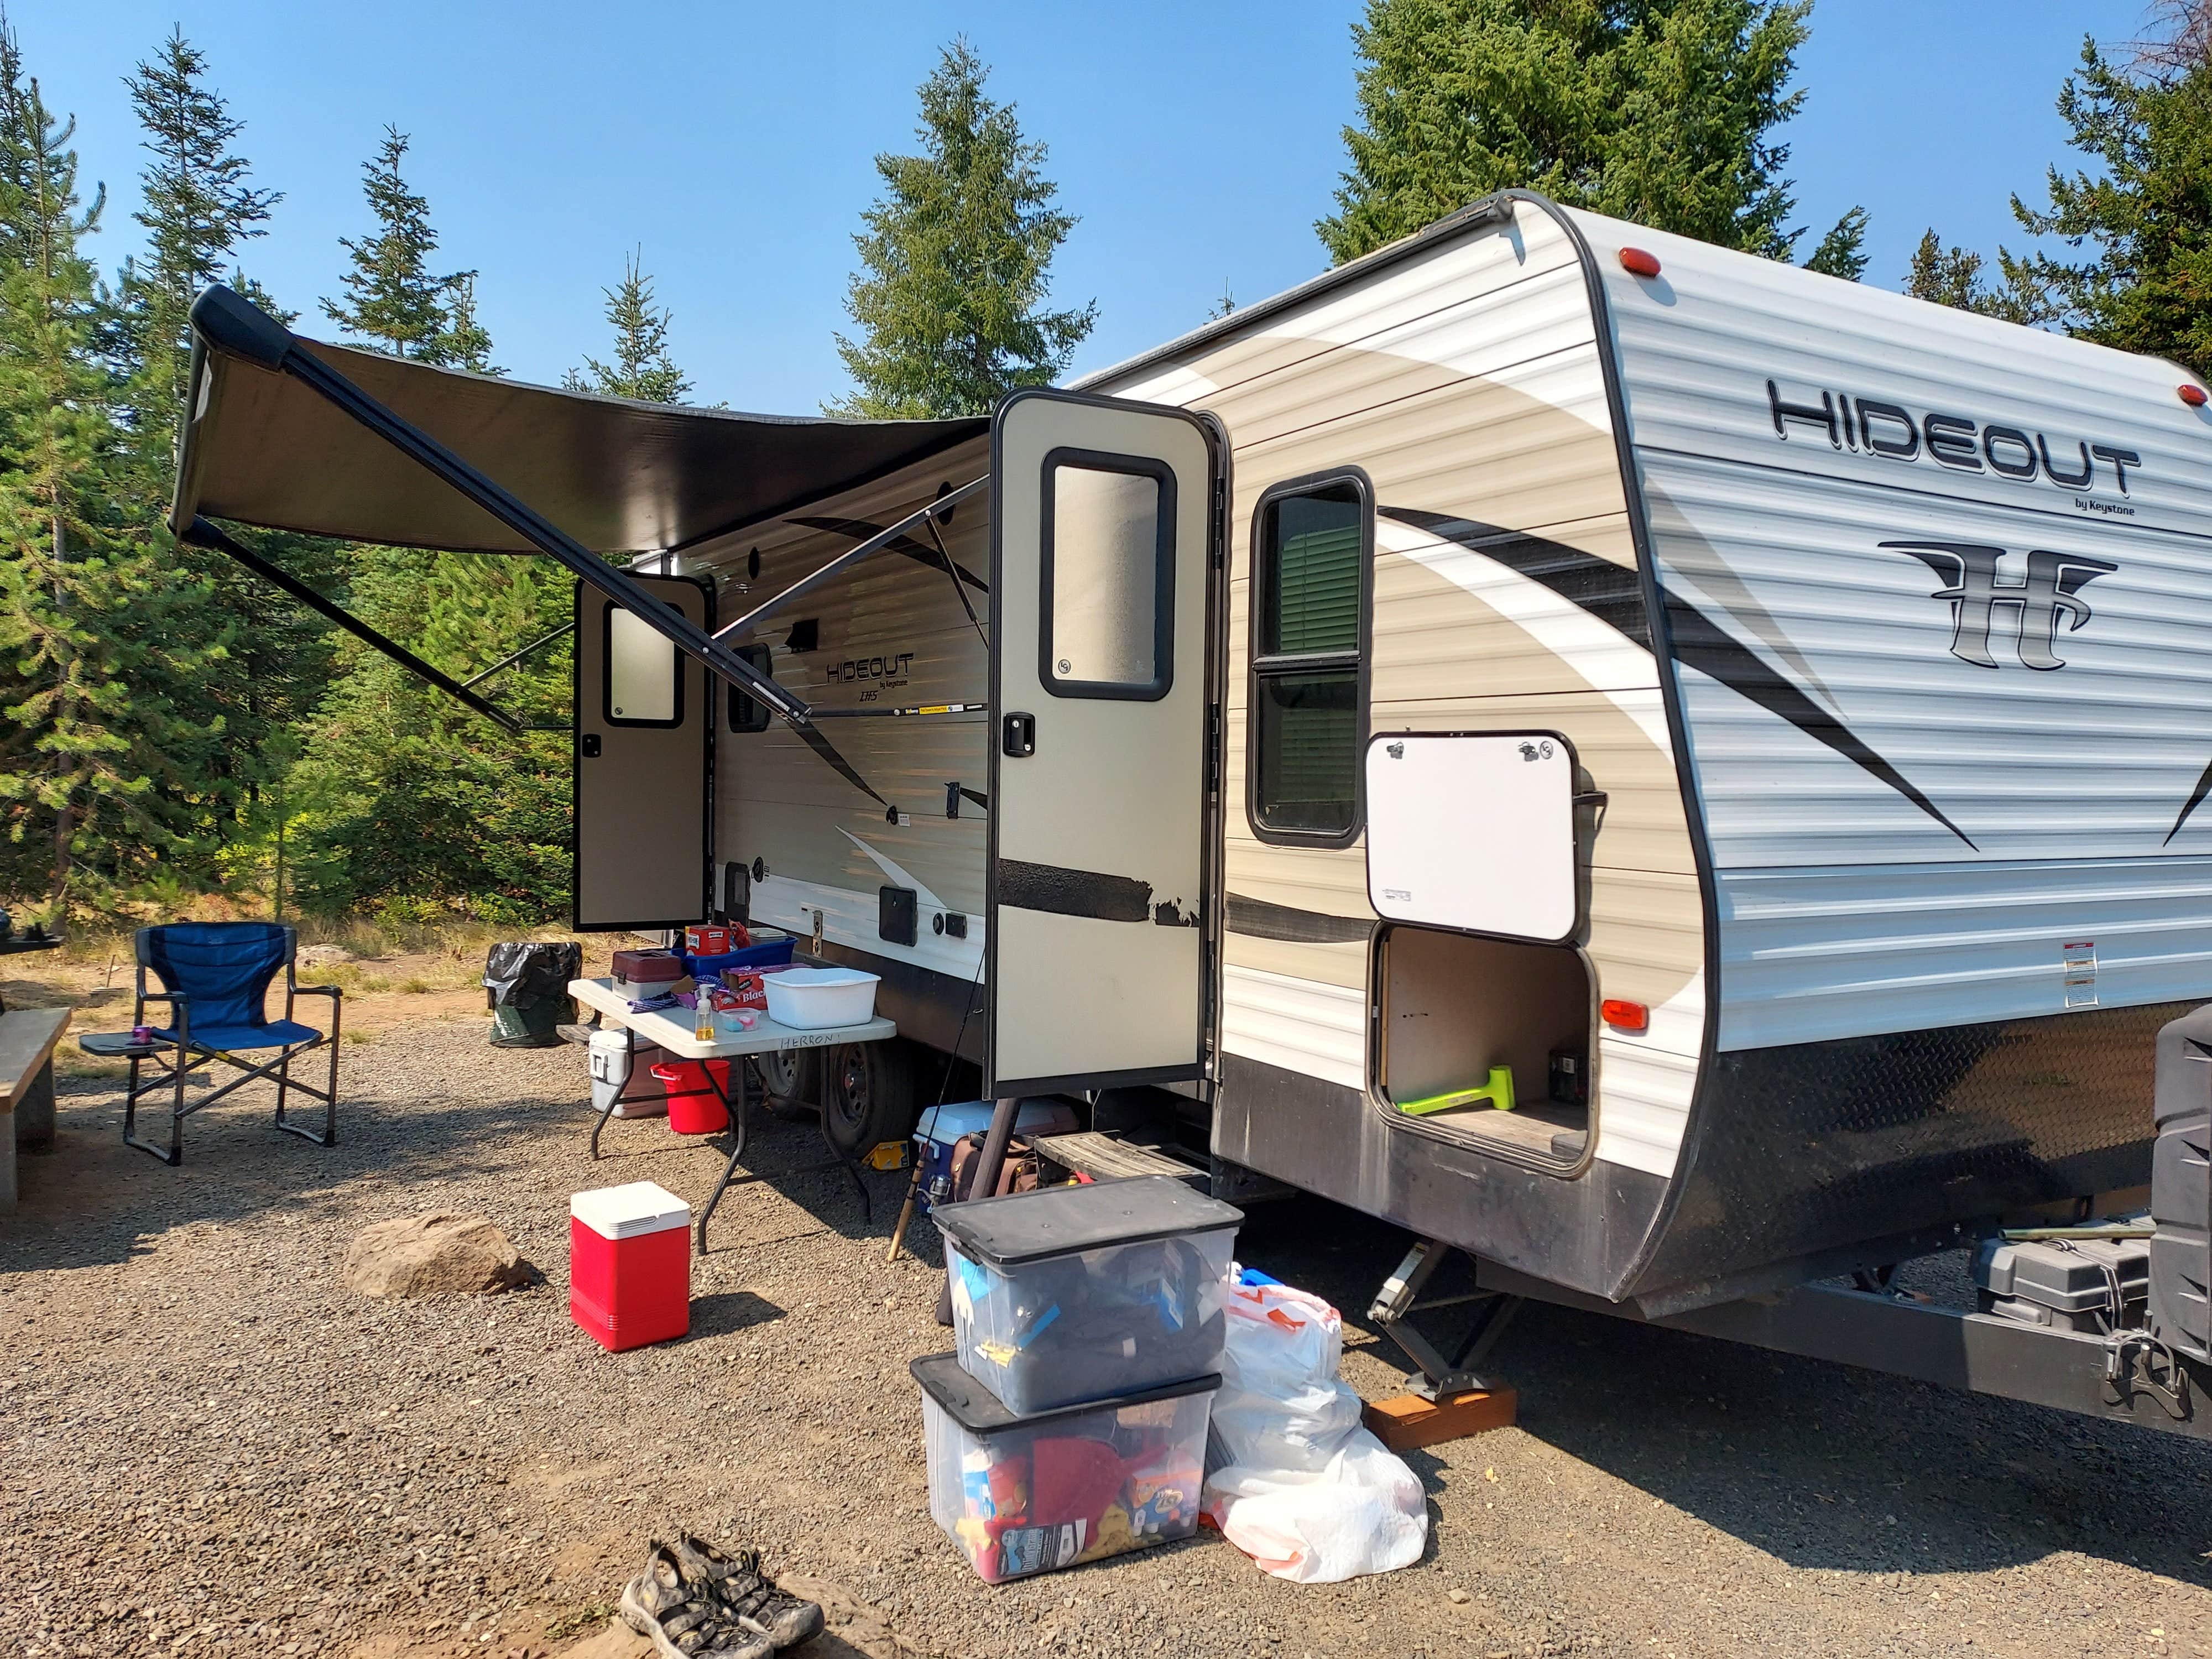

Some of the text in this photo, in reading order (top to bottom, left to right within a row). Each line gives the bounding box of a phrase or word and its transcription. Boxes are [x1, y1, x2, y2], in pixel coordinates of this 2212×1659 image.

[1766, 378, 2141, 499] HIDEOUT
[2075, 498, 2135, 516] by Keystone
[827, 653, 914, 684] HIDEOUT
